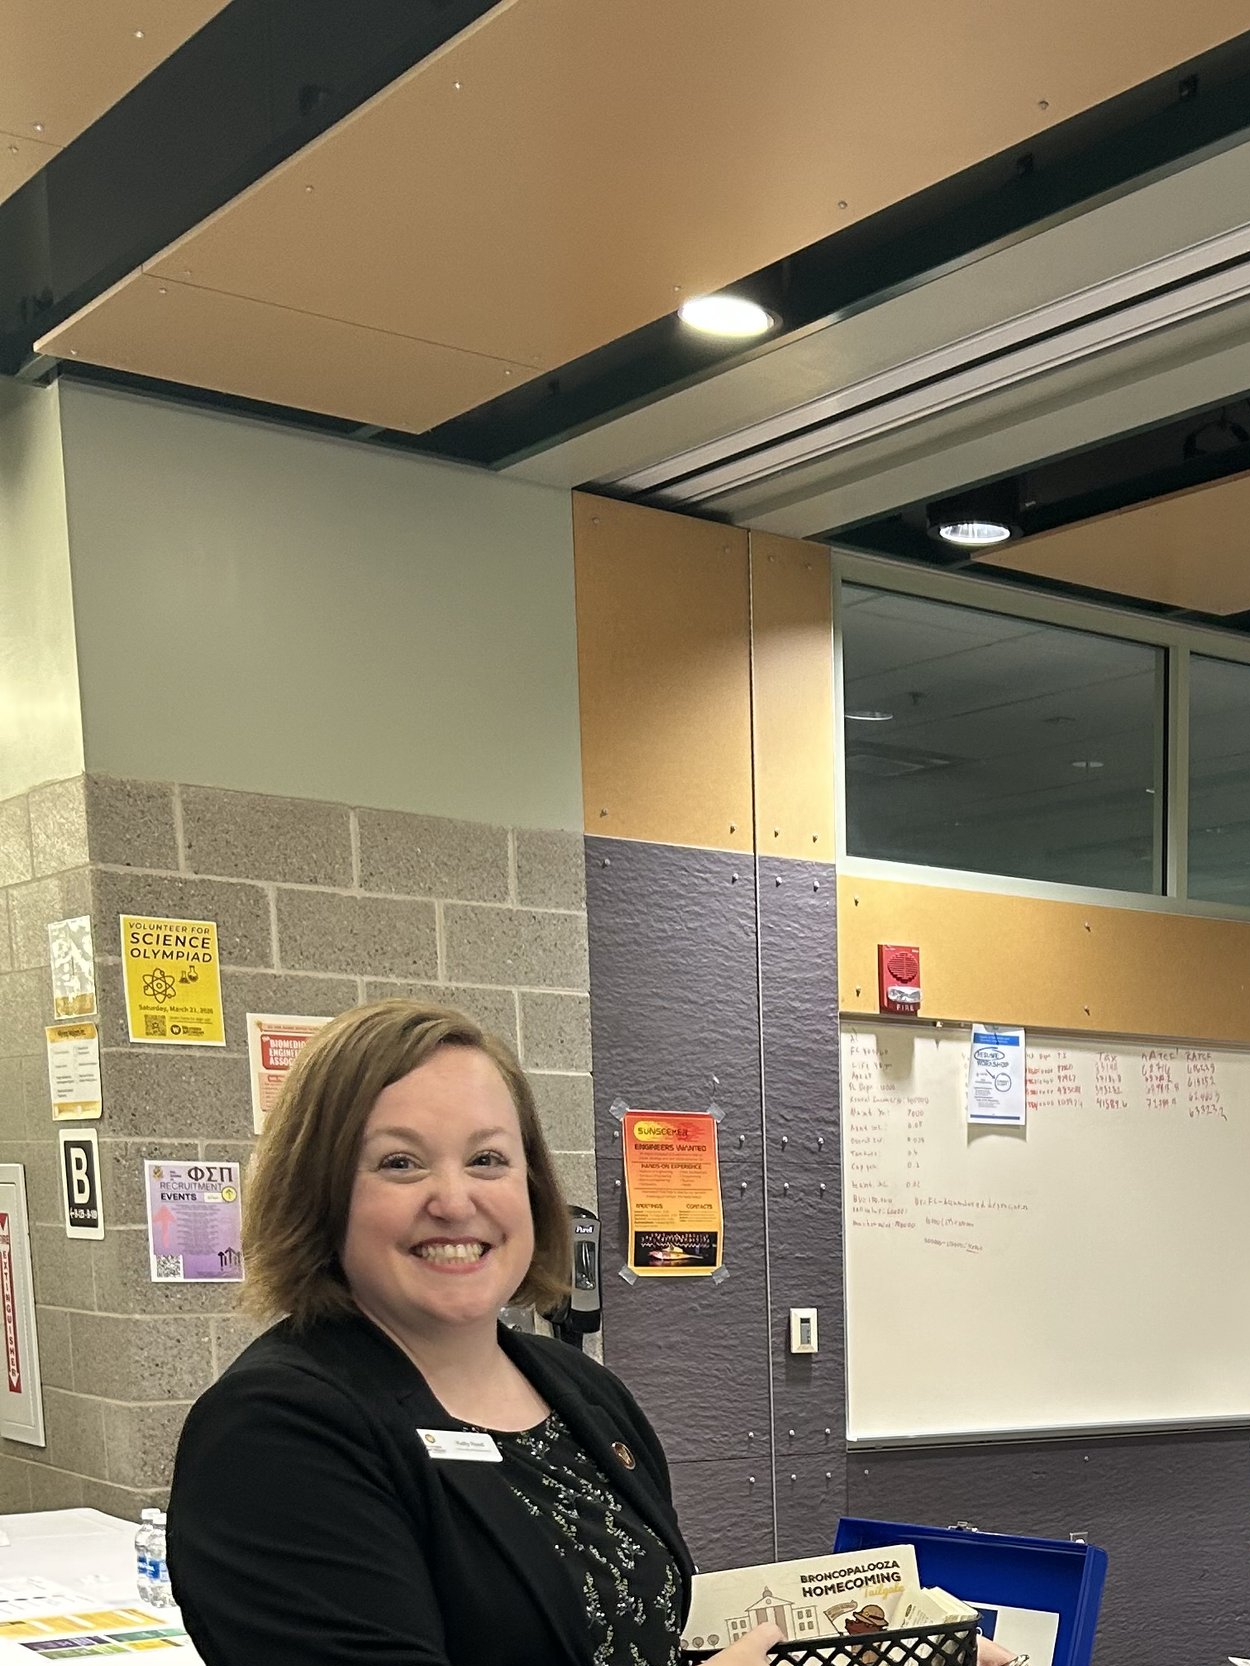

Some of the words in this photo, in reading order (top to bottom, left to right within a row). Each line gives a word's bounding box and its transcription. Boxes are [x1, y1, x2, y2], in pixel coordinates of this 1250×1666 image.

[129, 922, 188, 932] VOLUNTEER
[191, 927, 210, 935] FOR
[130, 932, 211, 949] SCIENCE
[130, 947, 212, 963] OLYMPIAD
[896, 1003, 914, 1012] FIRE
[70, 1147, 91, 1204] B
[187, 1166, 233, 1183] ΦΣΠ
[160, 1181, 222, 1191] RECRUITMENT
[160, 1192, 198, 1201] EVENTS
[800, 1560, 900, 1584] BRONCOPALOOZA
[802, 1571, 902, 1598] HOMECOMING
[864, 1584, 905, 1600] Tailgate
